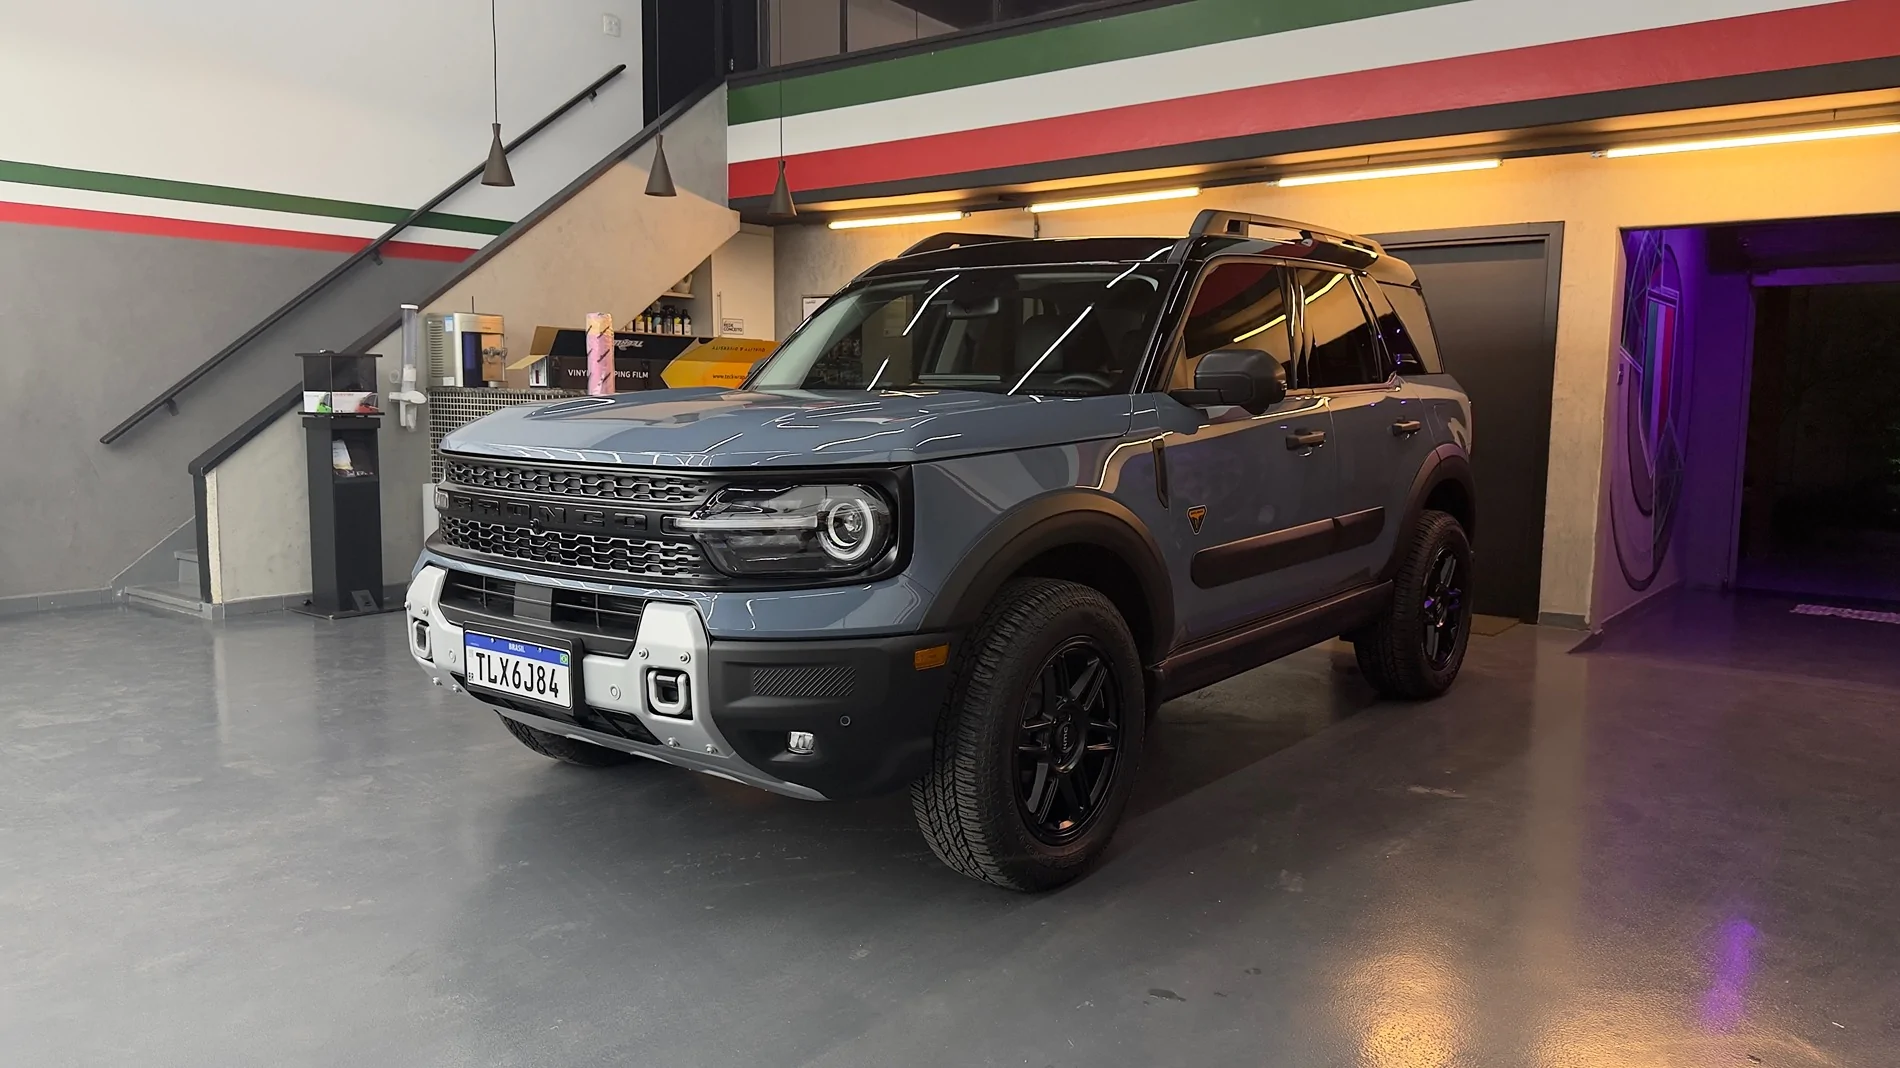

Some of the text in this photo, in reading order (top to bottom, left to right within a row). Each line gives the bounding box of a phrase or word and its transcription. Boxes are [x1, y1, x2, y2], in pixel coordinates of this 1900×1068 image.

[453, 495, 648, 531] BRONCO
[508, 642, 526, 653] BRASIL
[475, 652, 559, 698] TLX6J84
